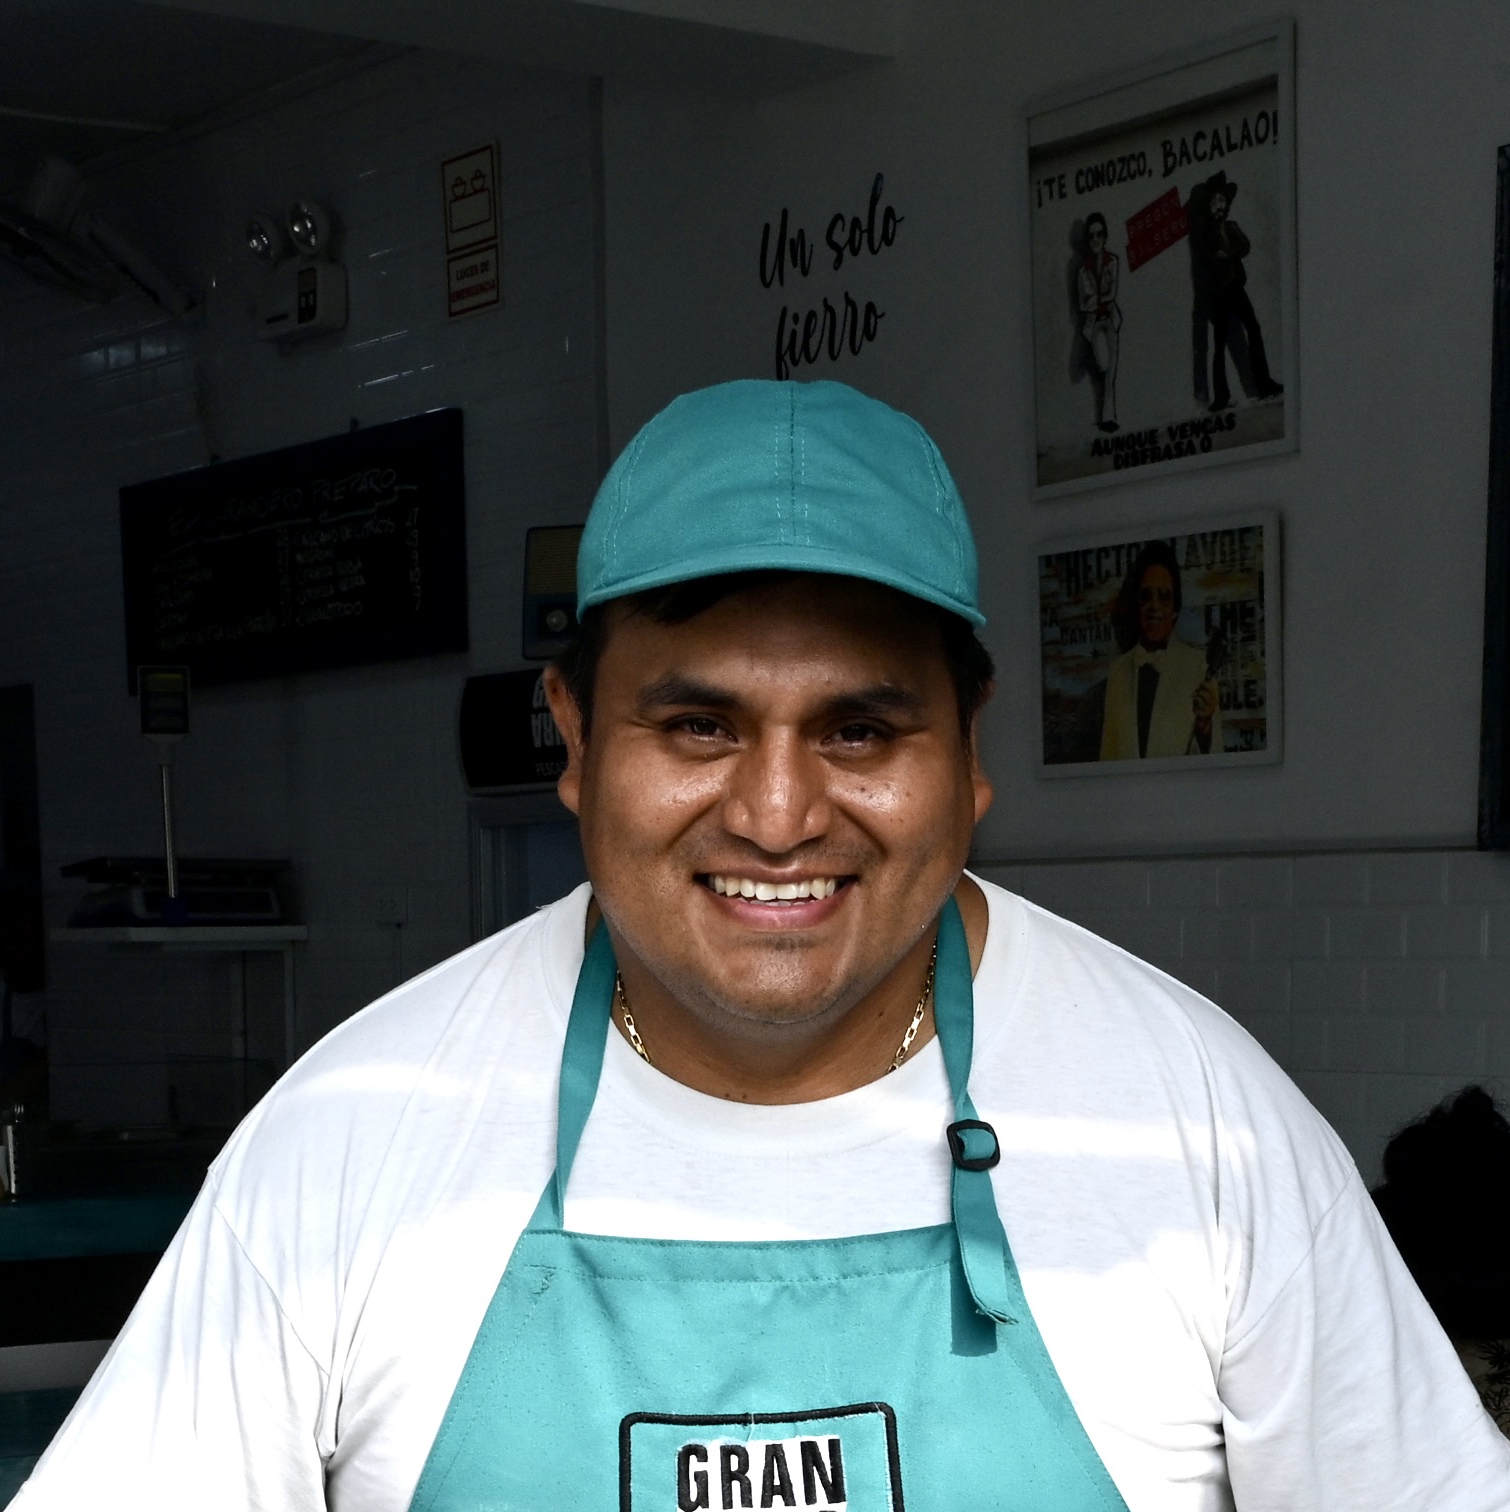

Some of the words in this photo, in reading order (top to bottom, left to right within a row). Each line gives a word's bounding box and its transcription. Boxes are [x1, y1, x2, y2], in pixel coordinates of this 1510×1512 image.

[1075, 151, 1153, 196] CONOZCO,
[1161, 109, 1279, 179] BACALAO!
[759, 208, 814, 289] Un
[825, 172, 905, 271] solo
[775, 291, 886, 381] fierro
[1091, 429, 1159, 459] AUNQUE
[1167, 412, 1237, 442] VENGAS
[1064, 540, 1141, 598] HECTO
